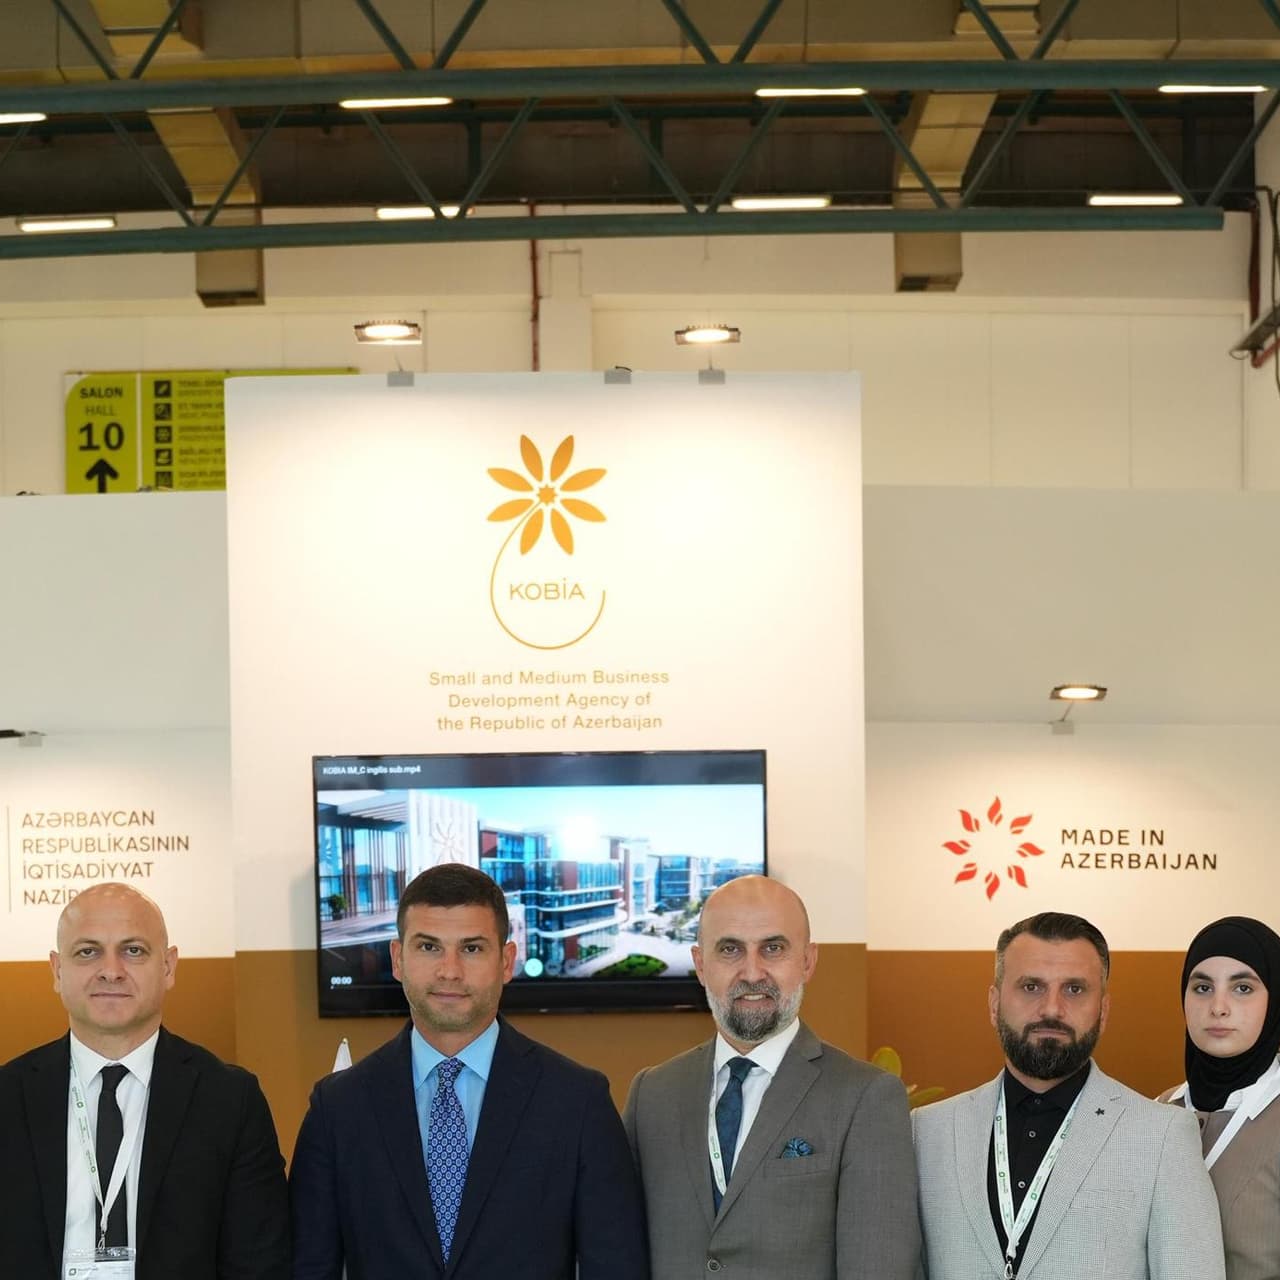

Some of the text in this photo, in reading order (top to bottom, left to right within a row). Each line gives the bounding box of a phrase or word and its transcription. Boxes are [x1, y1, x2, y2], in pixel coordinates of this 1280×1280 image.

[80, 387, 123, 399] SALON
[85, 405, 116, 416] HALL
[79, 421, 125, 451] 10
[509, 577, 586, 601] KOBİA
[429, 669, 670, 686] Small and Medium Business
[448, 692, 652, 710] Development Agency of
[437, 715, 662, 733] the Republic of Azerbaijan
[22, 810, 155, 829] AZƏRBAYCAN
[22, 833, 190, 855] RESPUBLİKASININ
[1061, 829, 1165, 846] MADE IN
[23, 859, 155, 880] İQTİSADİYYAT
[1060, 853, 1218, 871] AZERBAIJAN
